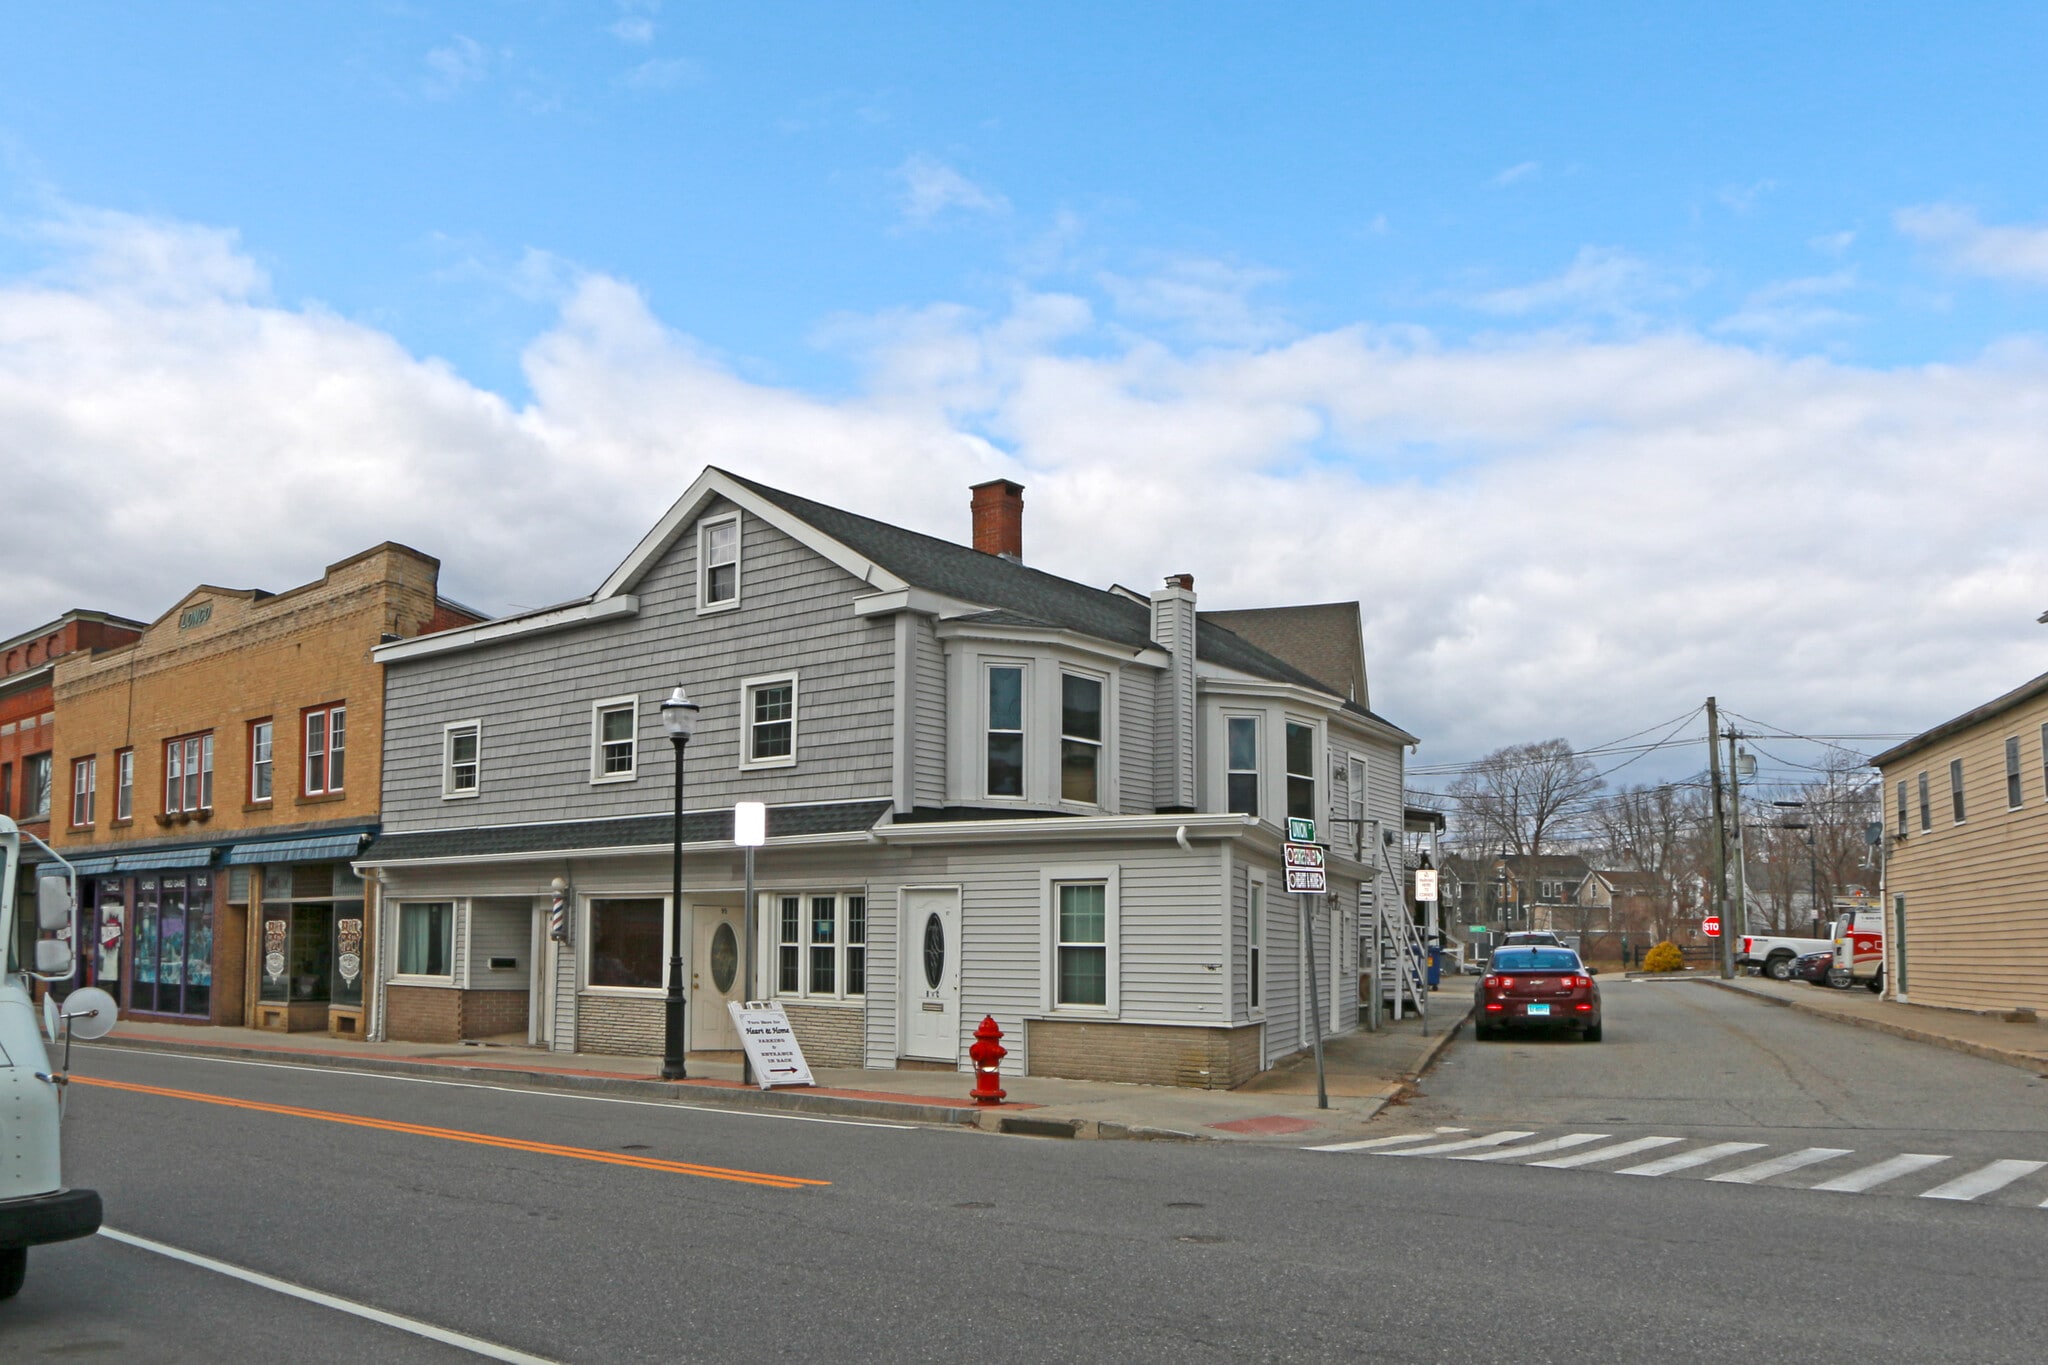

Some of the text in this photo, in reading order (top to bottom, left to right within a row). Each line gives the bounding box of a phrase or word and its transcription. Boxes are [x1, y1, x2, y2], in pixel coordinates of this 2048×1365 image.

[1291, 821, 1308, 838] UNION
[1703, 922, 1719, 931] STO
[745, 1027, 764, 1035] Heart
